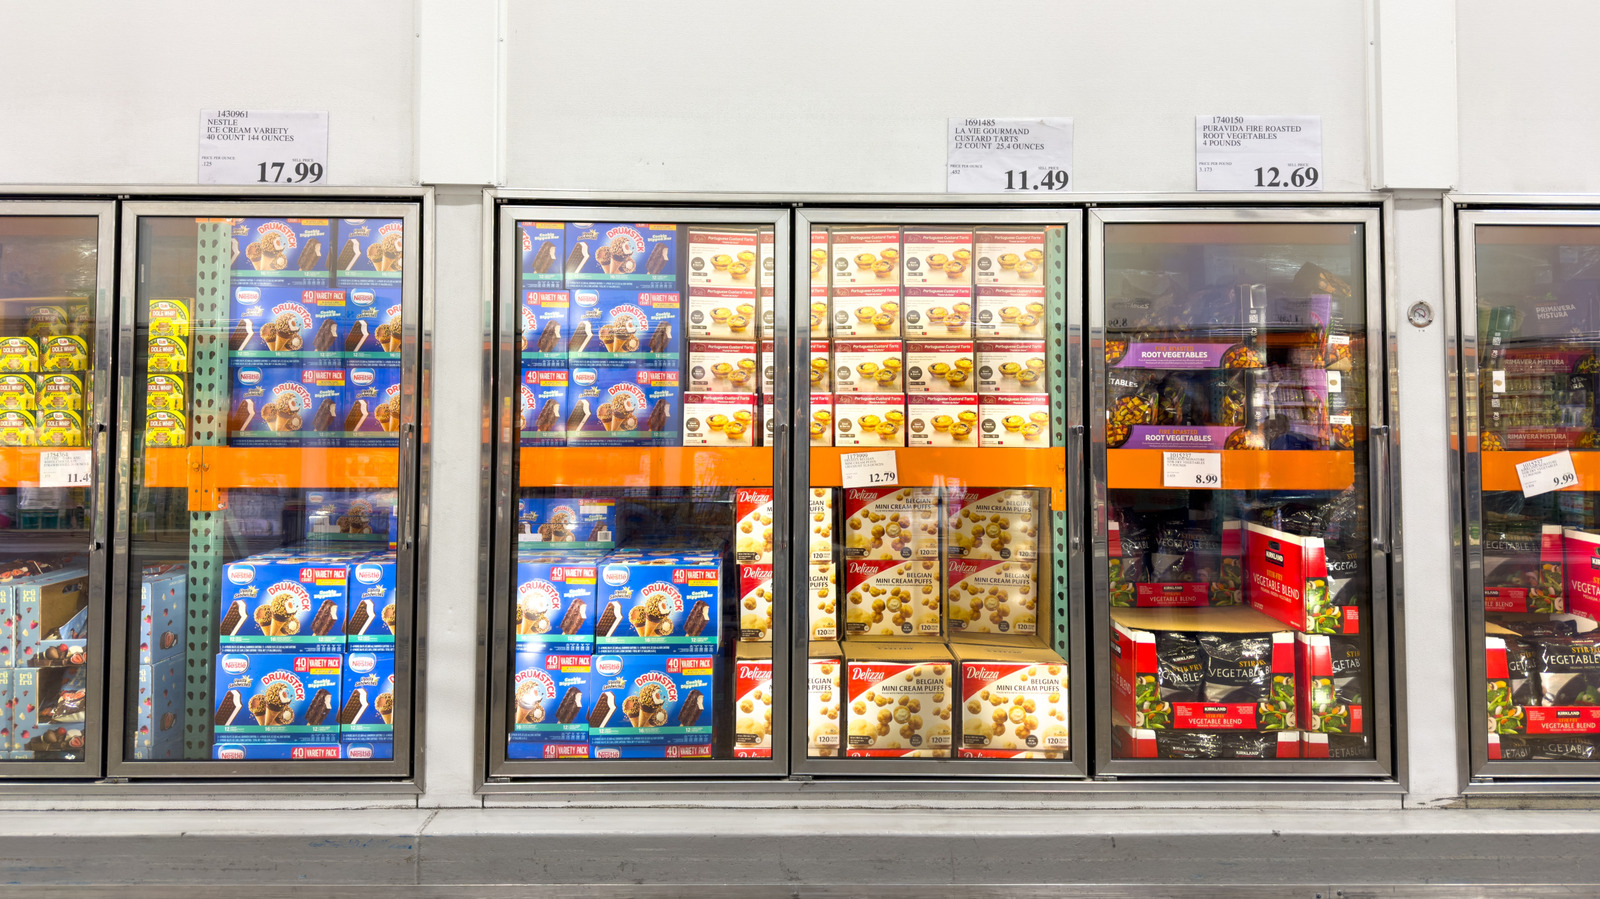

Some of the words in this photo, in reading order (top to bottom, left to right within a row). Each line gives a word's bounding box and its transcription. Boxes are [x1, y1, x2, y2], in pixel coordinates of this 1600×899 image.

[257, 162, 323, 183] 17.99
[1254, 167, 1319, 187] 12.69
[1005, 170, 1069, 190] 11.49
[258, 223, 298, 248] DRUMSTICK
[272, 383, 312, 409] DRUMSTICK
[609, 384, 647, 409] DRUMSTICK
[870, 472, 895, 482] 12.79
[1196, 474, 1218, 484] 8.99
[1553, 473, 1574, 486] 9.99
[740, 489, 770, 503] Delizza
[301, 568, 312, 578] 40
[674, 570, 684, 578] 40
[688, 570, 705, 578] VARIETY
[850, 562, 879, 574] Delizza
[1253, 572, 1280, 593] VEGETABLE
[1282, 585, 1299, 600] BLEND
[268, 582, 310, 611] DRUMSTICK
[642, 584, 683, 611] DRUMSTICK
[561, 656, 578, 665] VARIETY
[1546, 655, 1600, 664] VEGETABLE
[740, 666, 772, 680] Delizza
[852, 668, 884, 681] Delizza
[967, 666, 999, 680] Delizza
[262, 671, 305, 700] DRUMSTICK
